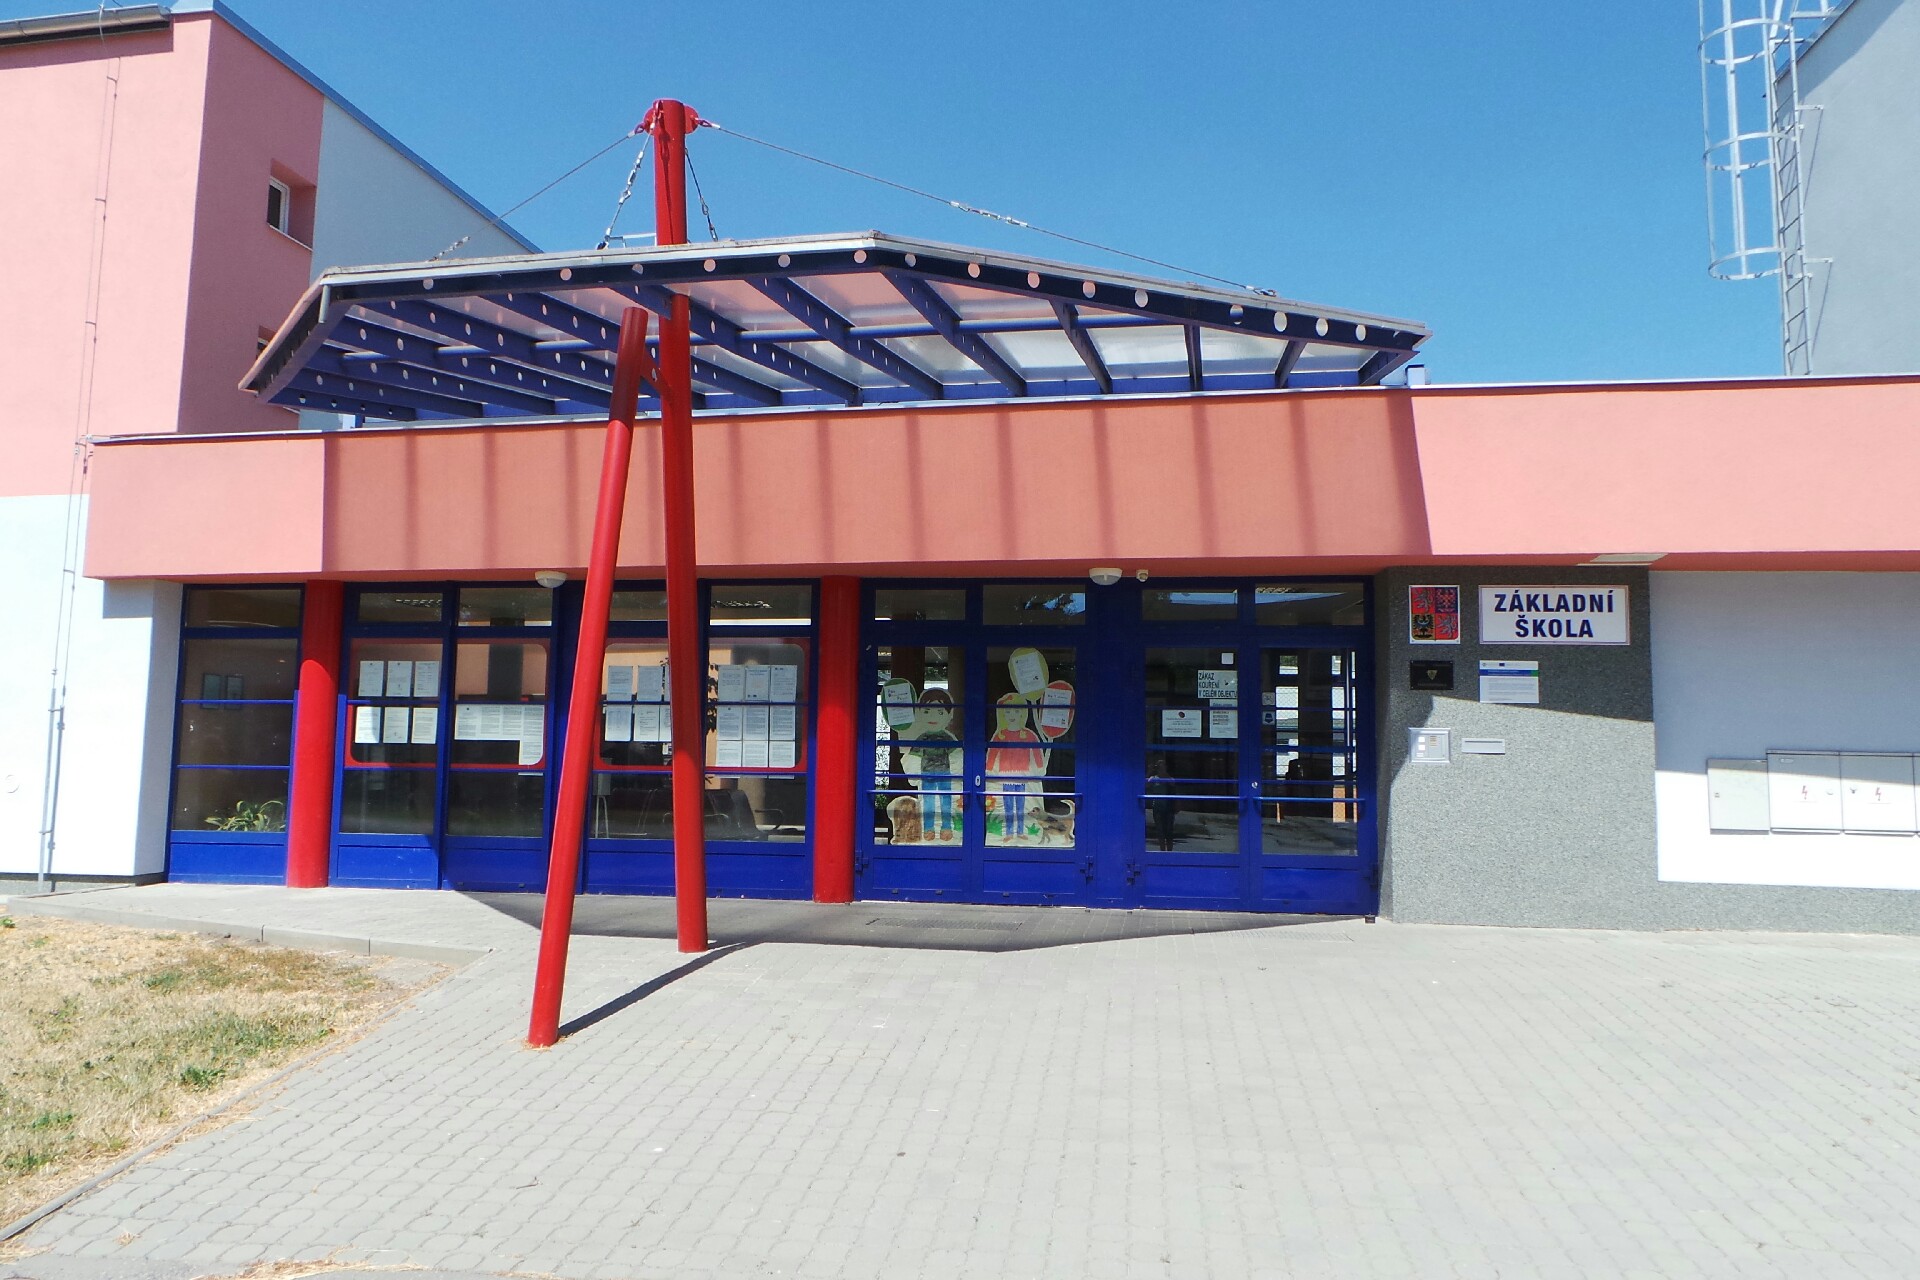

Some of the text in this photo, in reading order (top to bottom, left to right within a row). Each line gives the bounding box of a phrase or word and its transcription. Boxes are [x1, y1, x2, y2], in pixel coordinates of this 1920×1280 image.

[1494, 589, 1614, 613] ZÁKLADNÍ
[1515, 614, 1593, 638] ŠKOLA
[1198, 671, 1215, 681] ZÁKAZ
